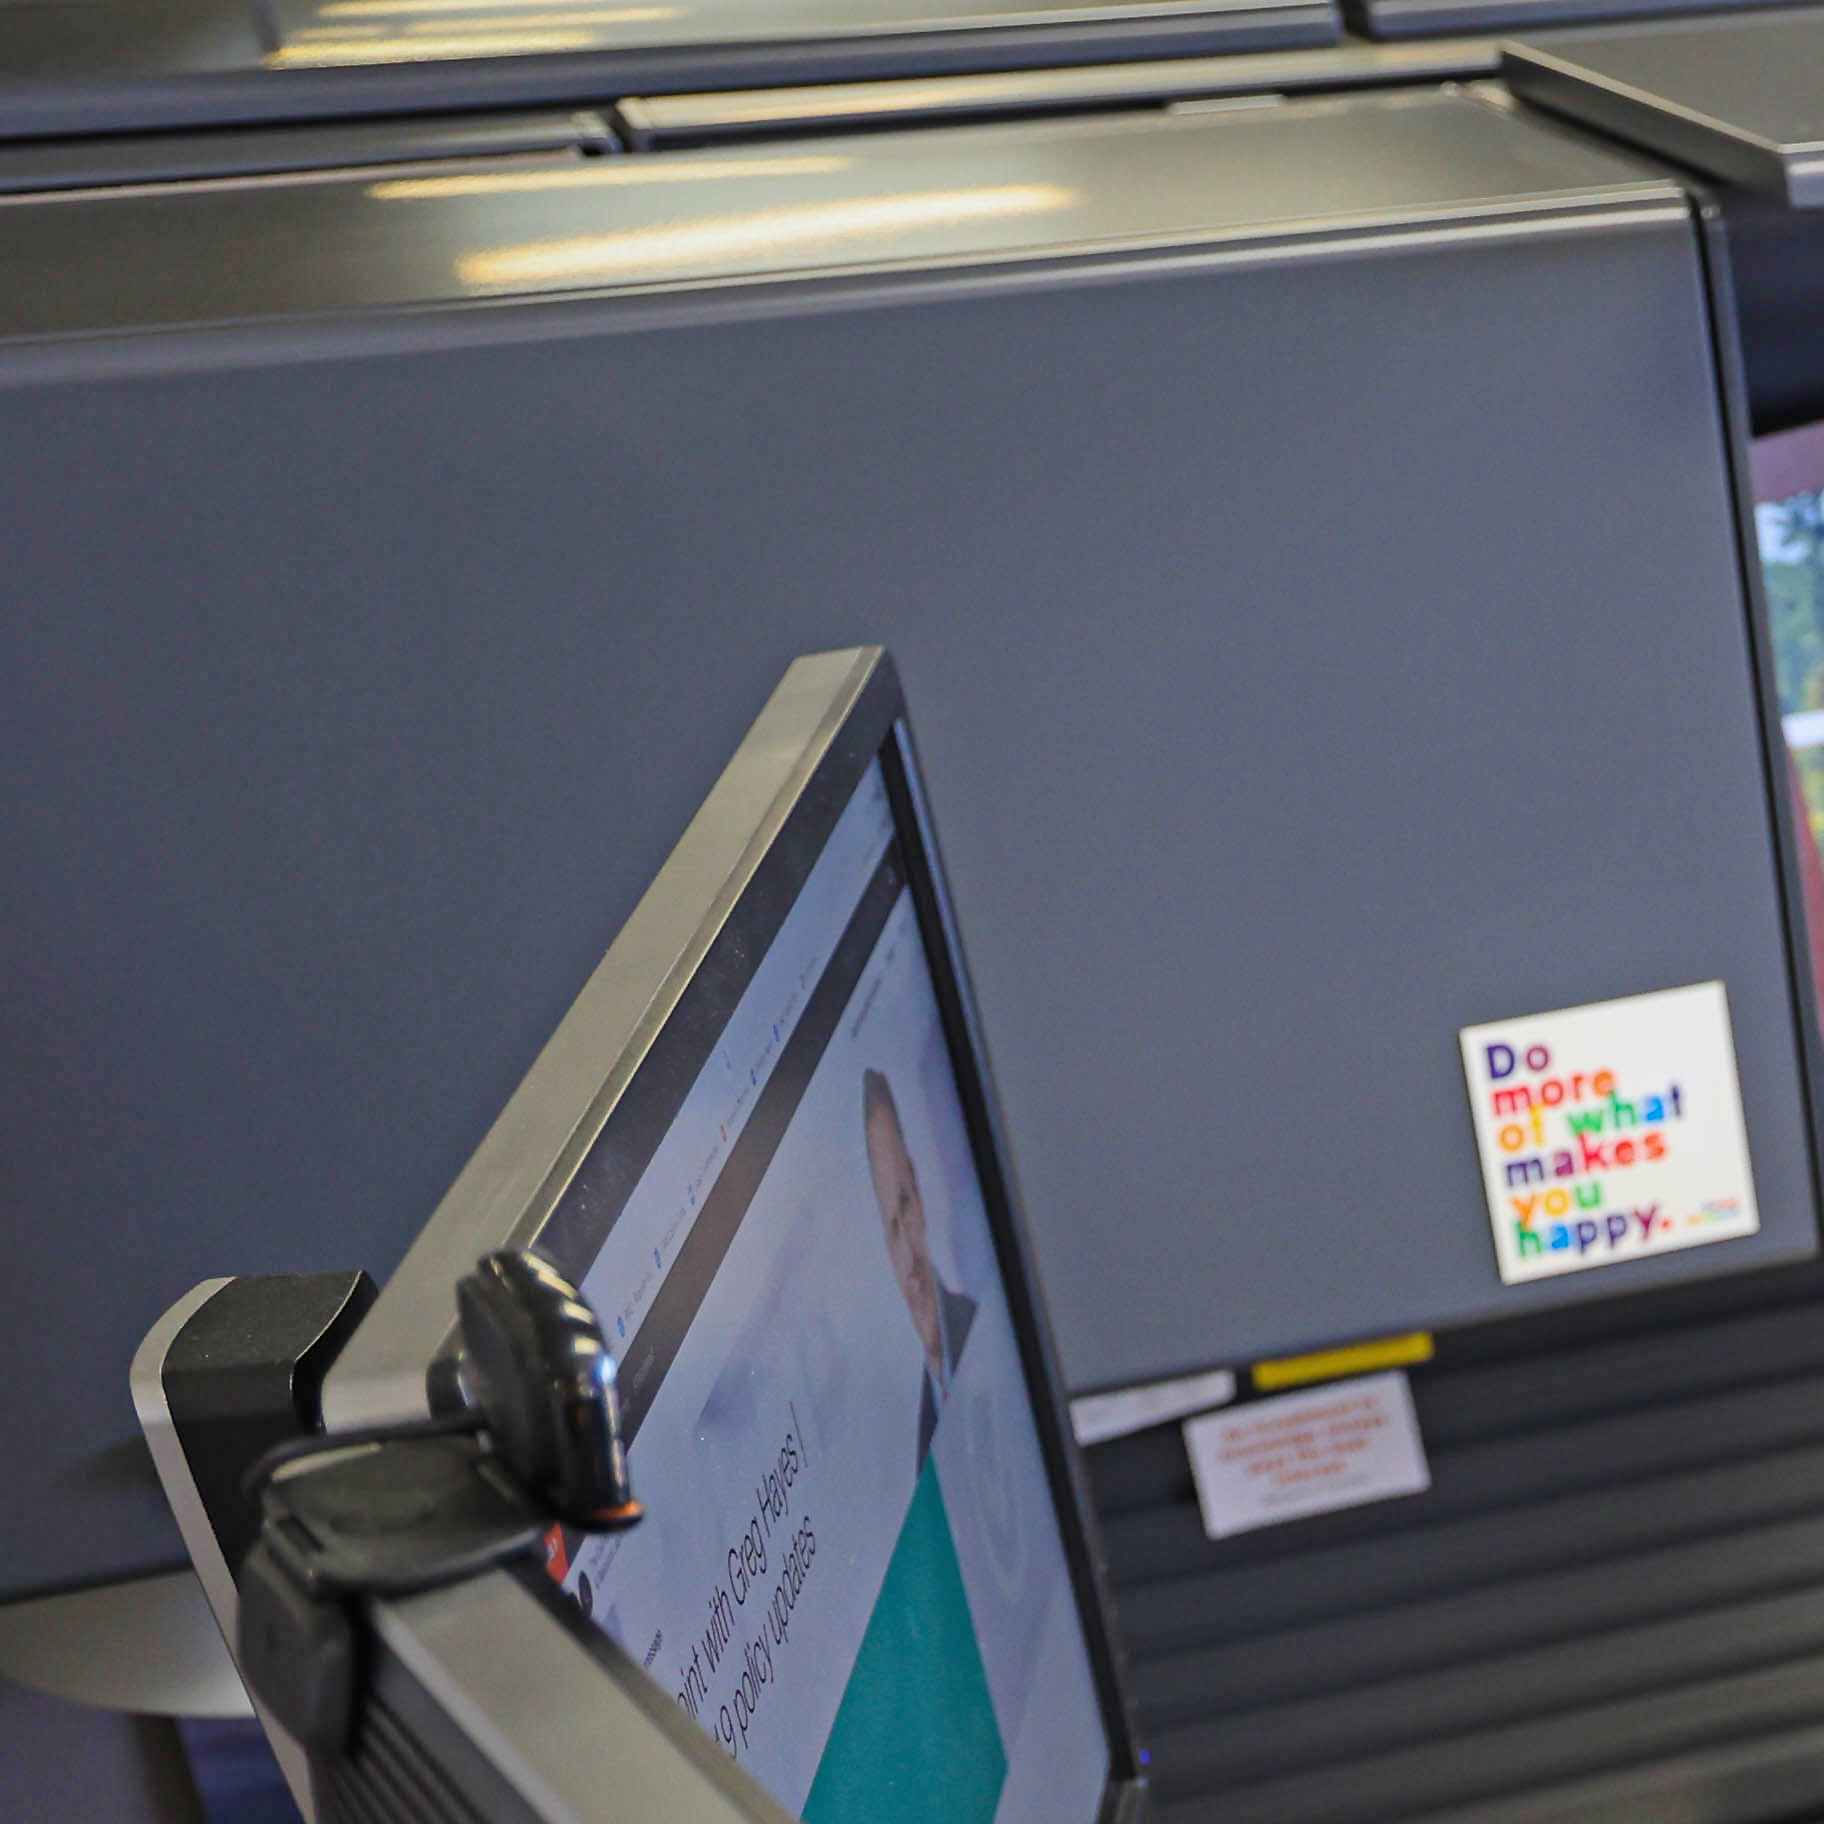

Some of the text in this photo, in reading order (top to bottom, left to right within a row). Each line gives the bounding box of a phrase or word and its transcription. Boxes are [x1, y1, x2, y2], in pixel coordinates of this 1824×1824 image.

[1484, 1041, 1552, 1081] Do
[1491, 1069, 1617, 1118] more
[1498, 1086, 1684, 1152] of what
[1506, 1132, 1668, 1187] makes
[1508, 1180, 1604, 1230] you
[1516, 1204, 1674, 1260] happy.
[702, 1585, 735, 1674] with
[728, 1517, 767, 1606] Greg
[755, 1433, 798, 1538] Hayes
[734, 1624, 774, 1750] policy
[767, 1516, 816, 1645] updates
